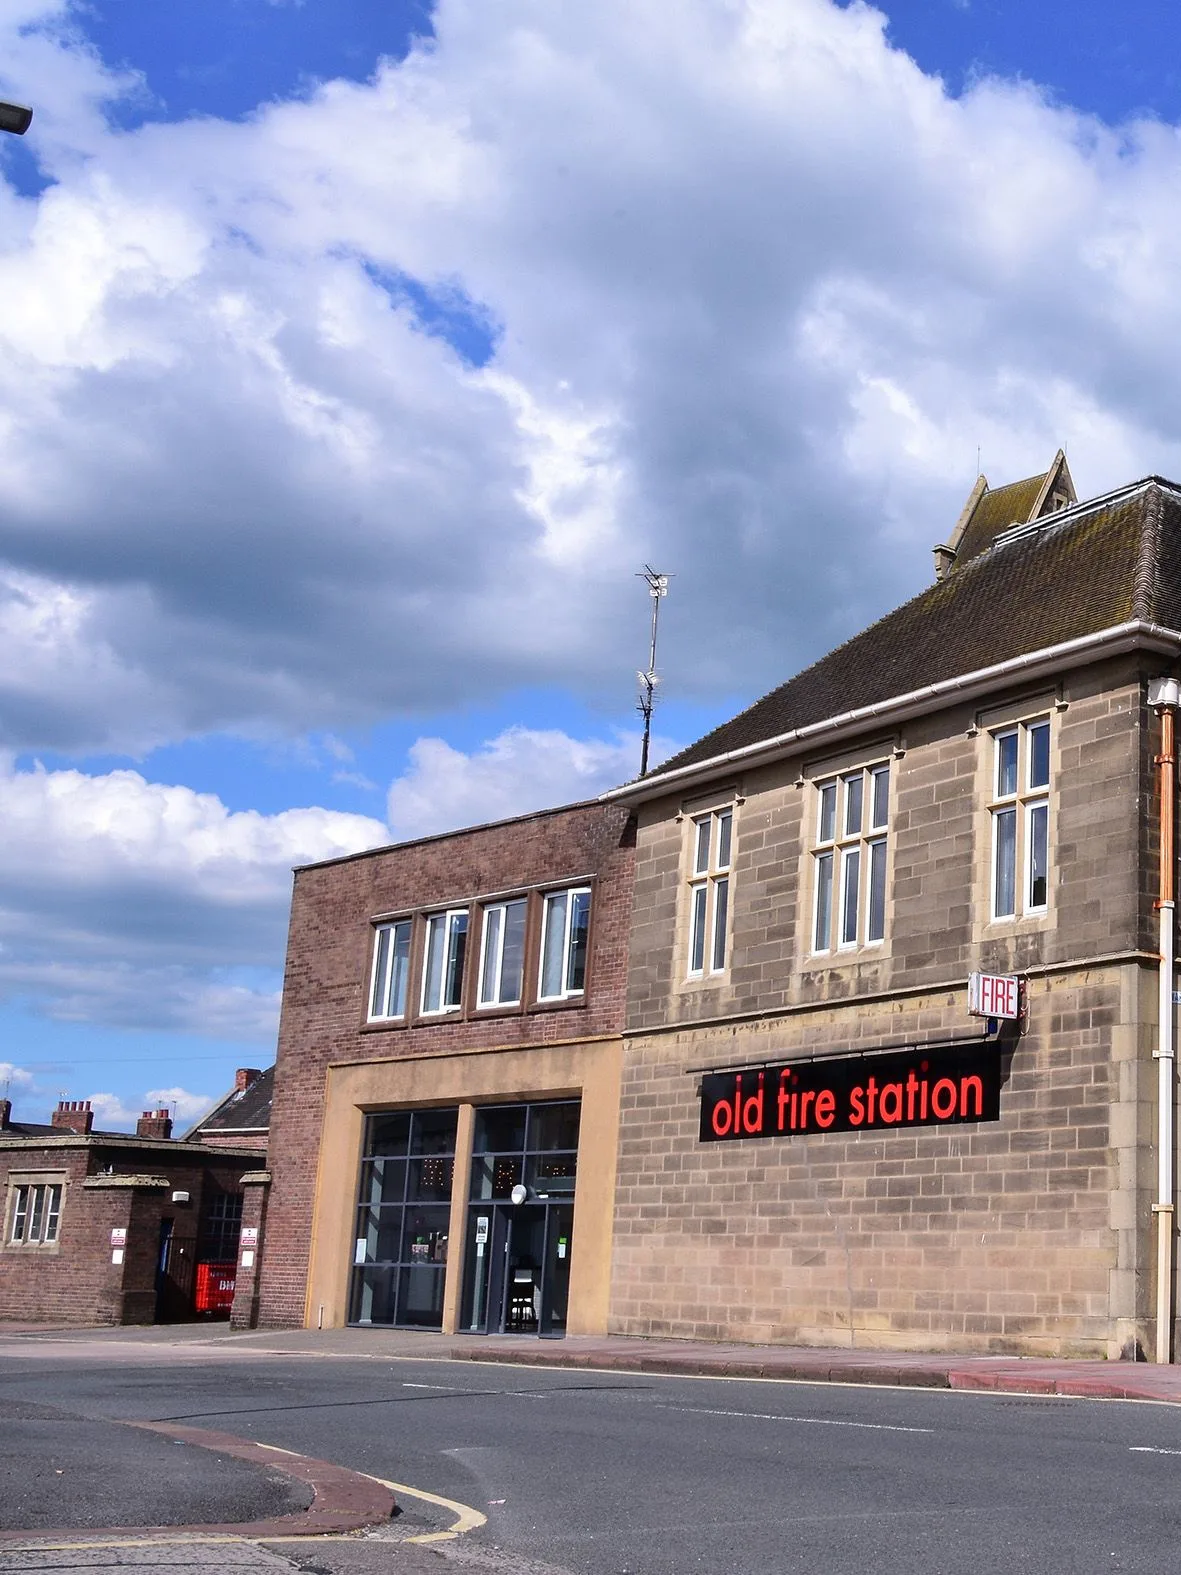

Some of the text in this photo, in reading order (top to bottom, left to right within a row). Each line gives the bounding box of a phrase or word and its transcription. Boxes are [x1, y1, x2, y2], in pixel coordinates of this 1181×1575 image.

[982, 976, 1015, 1014] FIRE
[712, 1060, 983, 1136] old fire station
